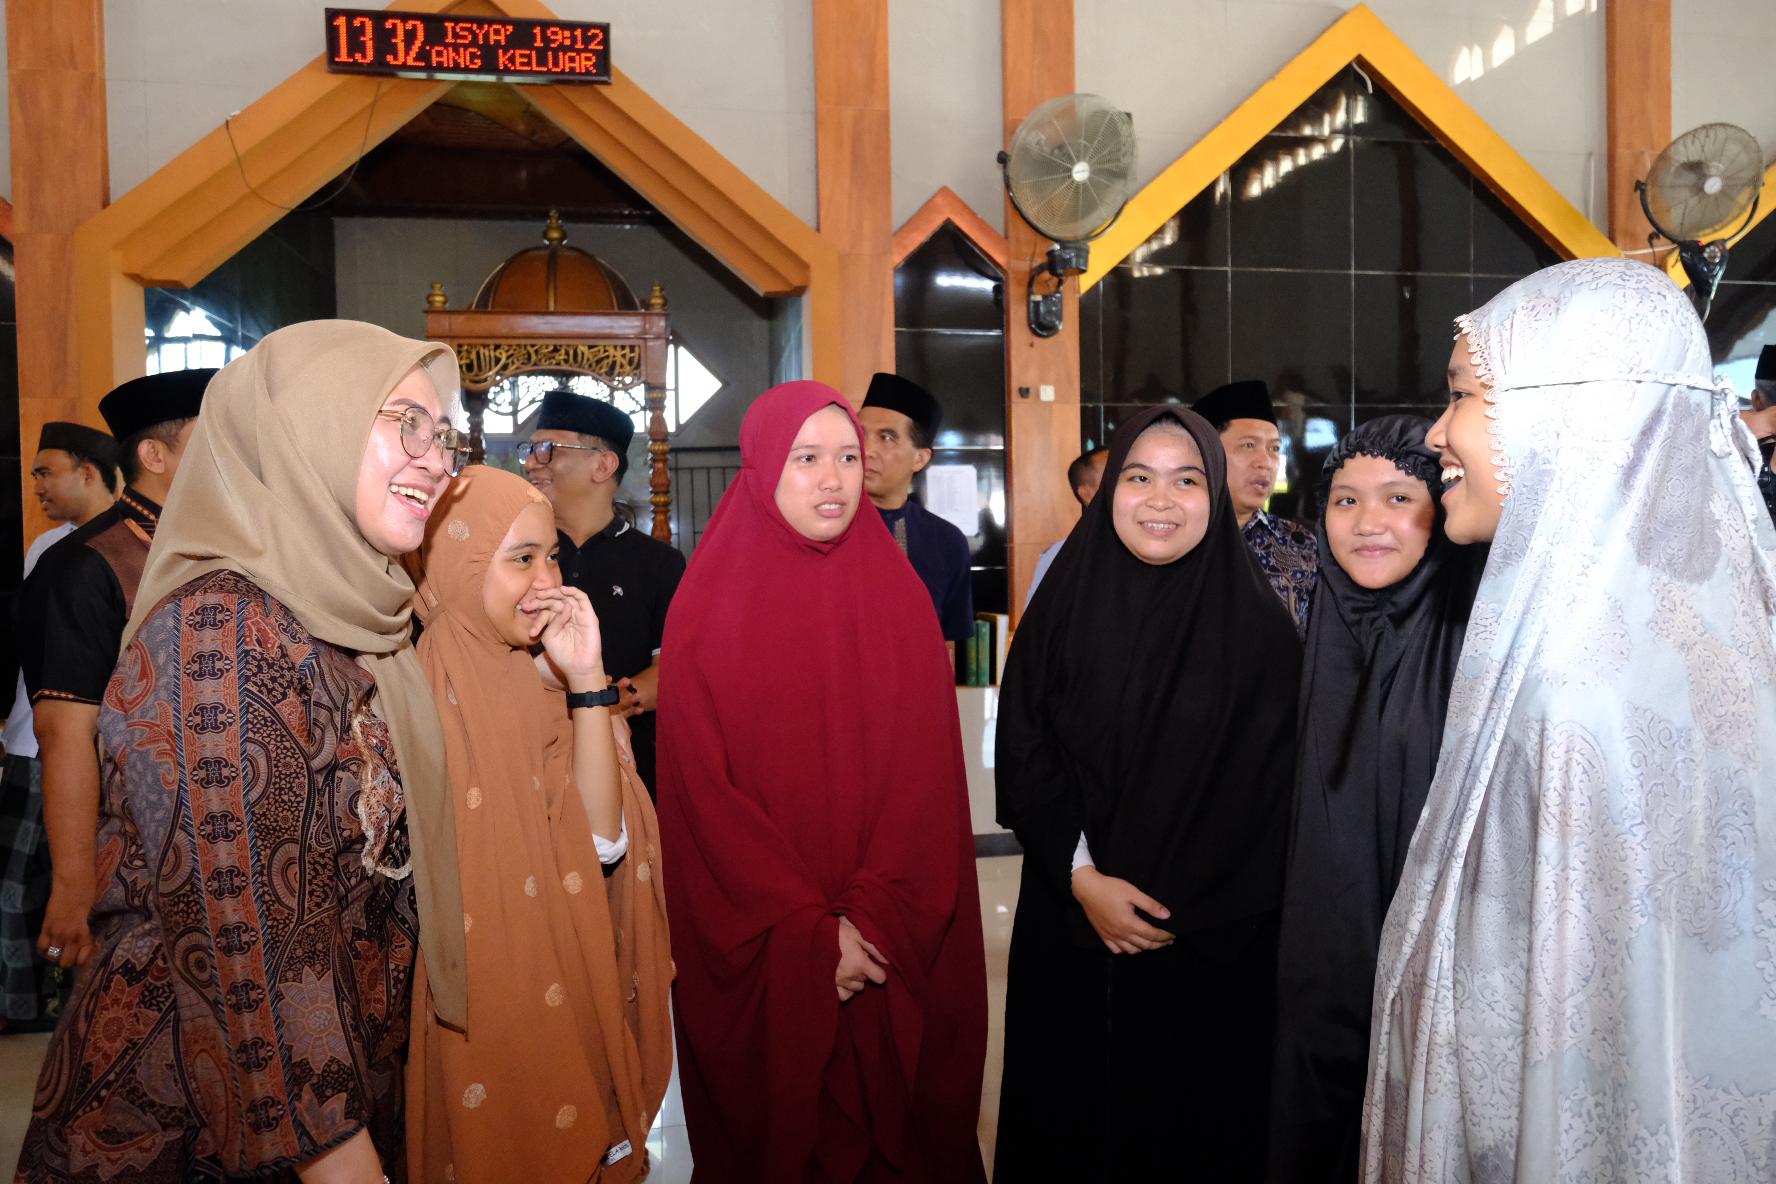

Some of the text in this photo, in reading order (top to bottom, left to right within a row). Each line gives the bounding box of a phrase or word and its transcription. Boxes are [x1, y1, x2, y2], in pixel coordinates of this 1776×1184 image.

[332, 15, 426, 66] 13 32
[532, 26, 604, 50] 19:12
[425, 46, 597, 73] ANG KELUAR
